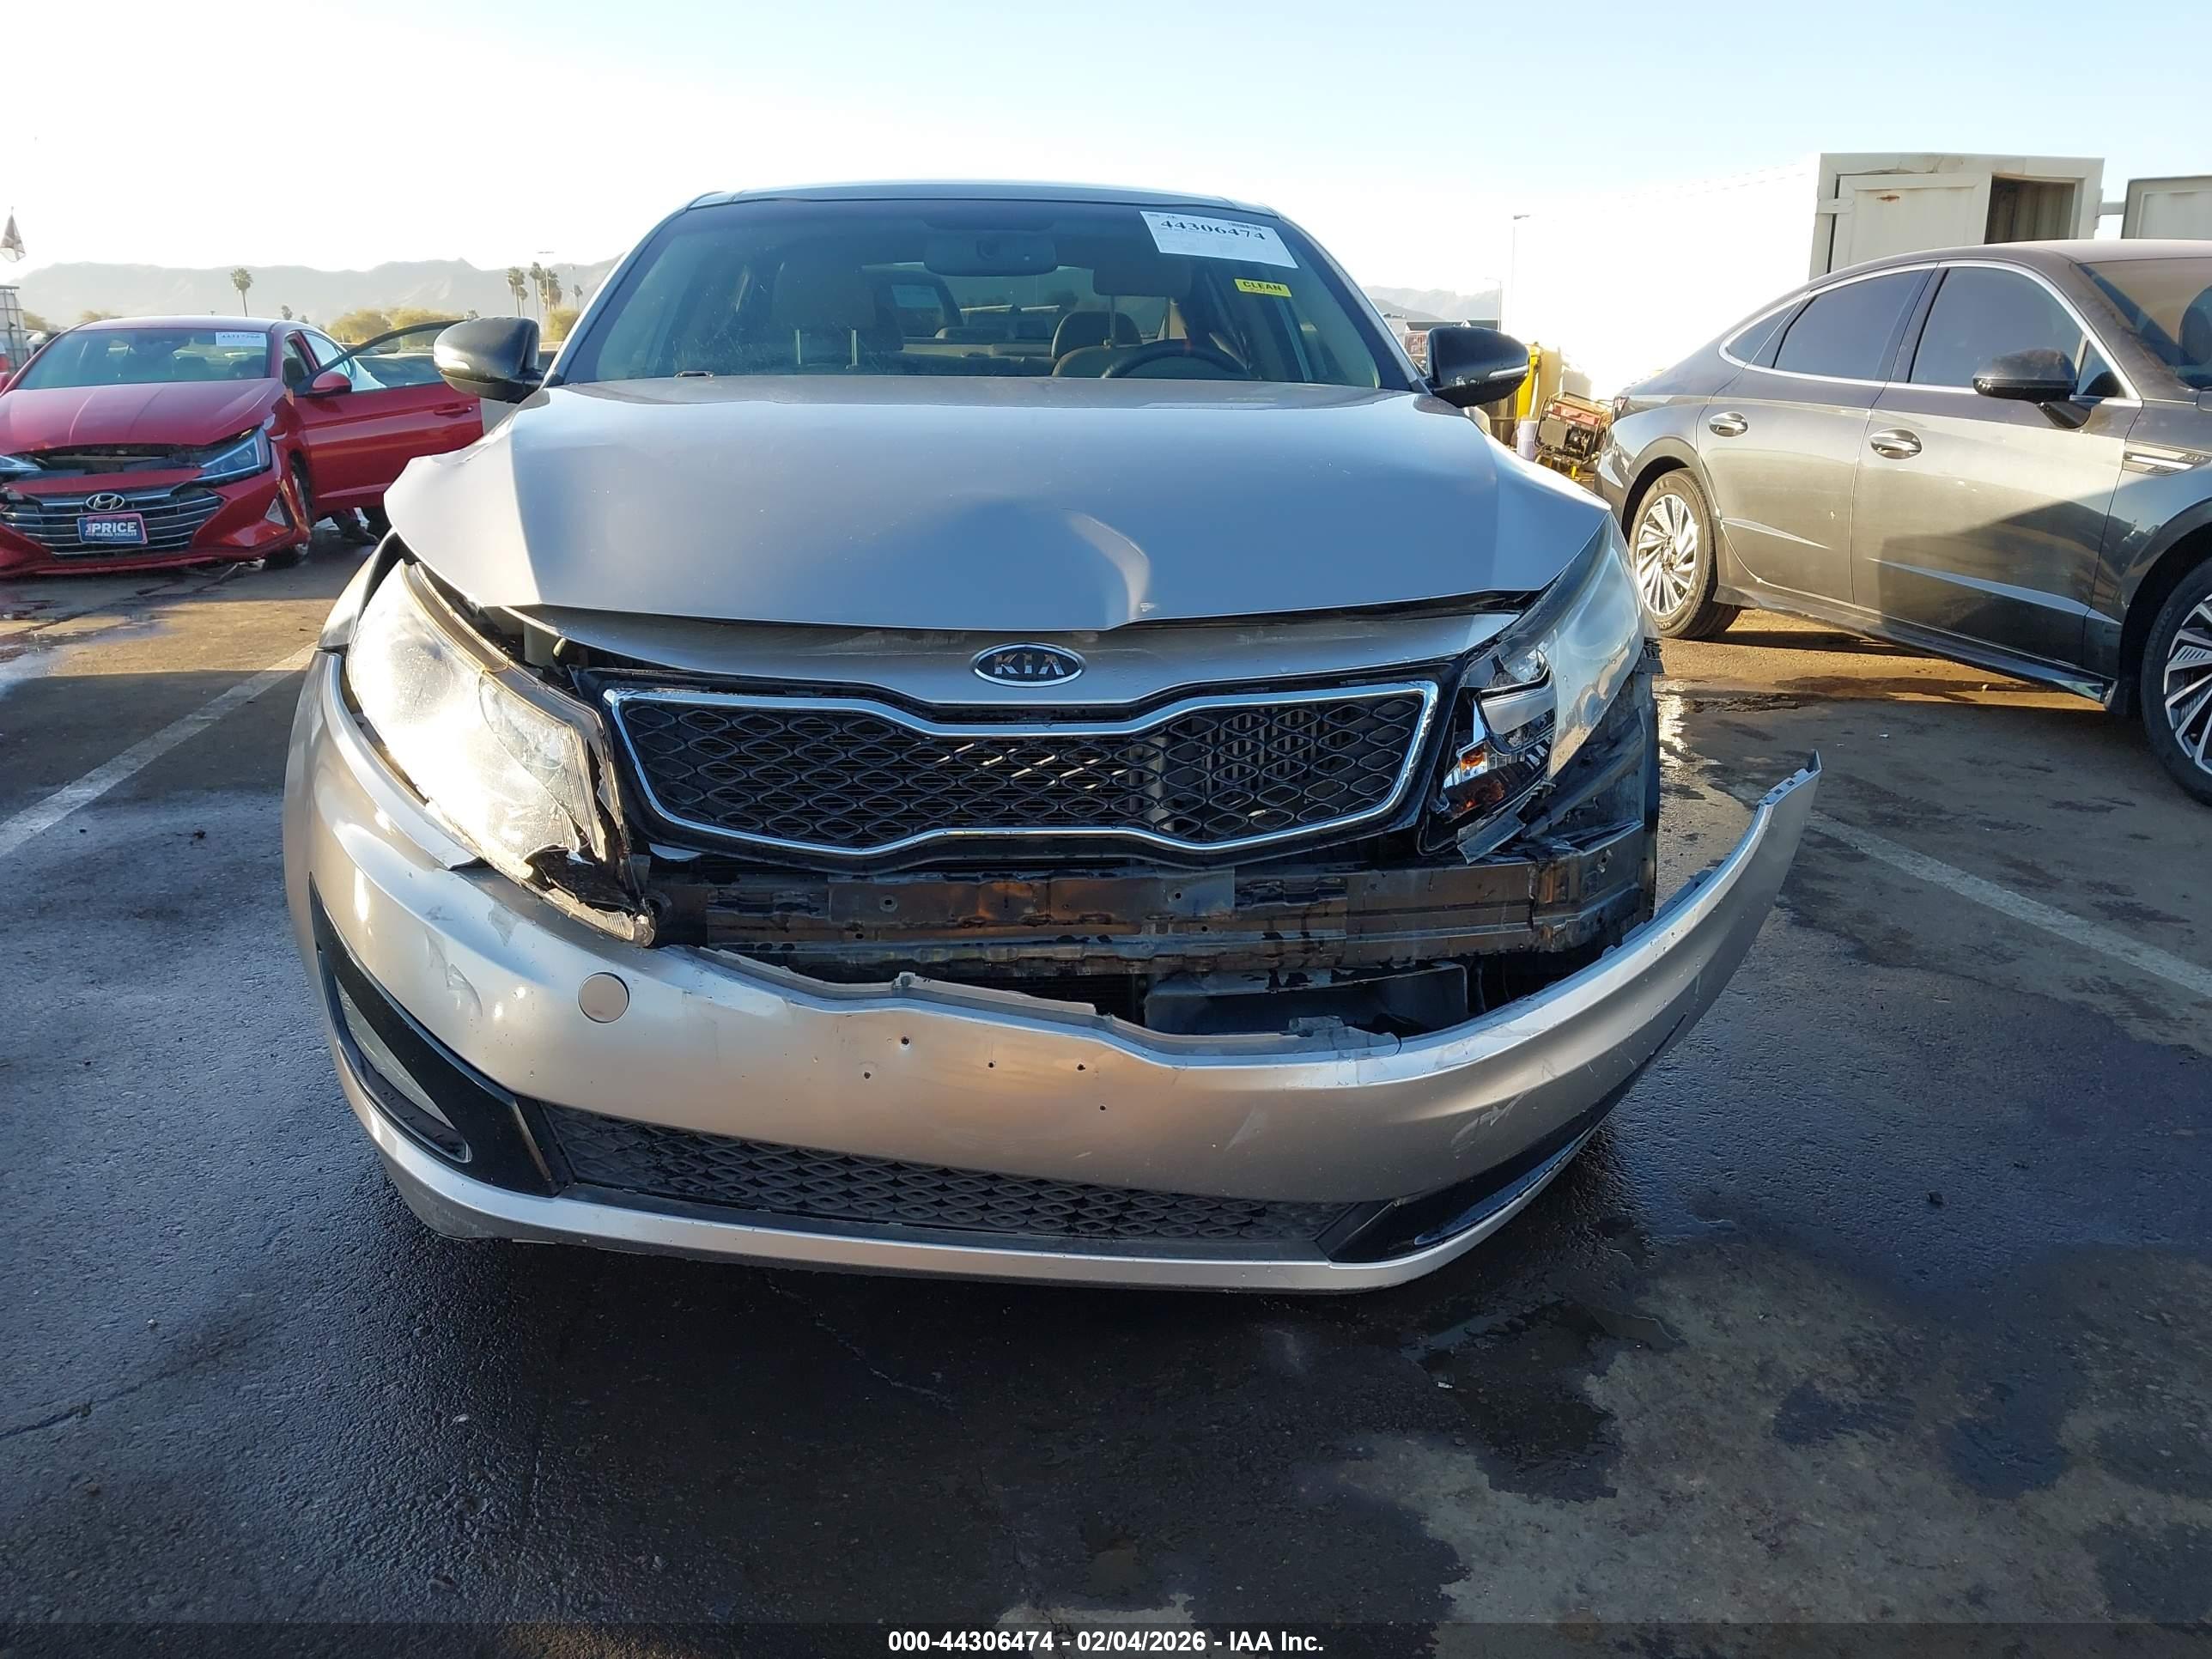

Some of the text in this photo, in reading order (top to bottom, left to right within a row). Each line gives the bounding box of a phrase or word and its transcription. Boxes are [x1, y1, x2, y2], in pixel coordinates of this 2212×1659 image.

[1160, 220, 1266, 240] 44306474
[1243, 281, 1282, 291] CLEAN
[994, 653, 1066, 676] KIA
